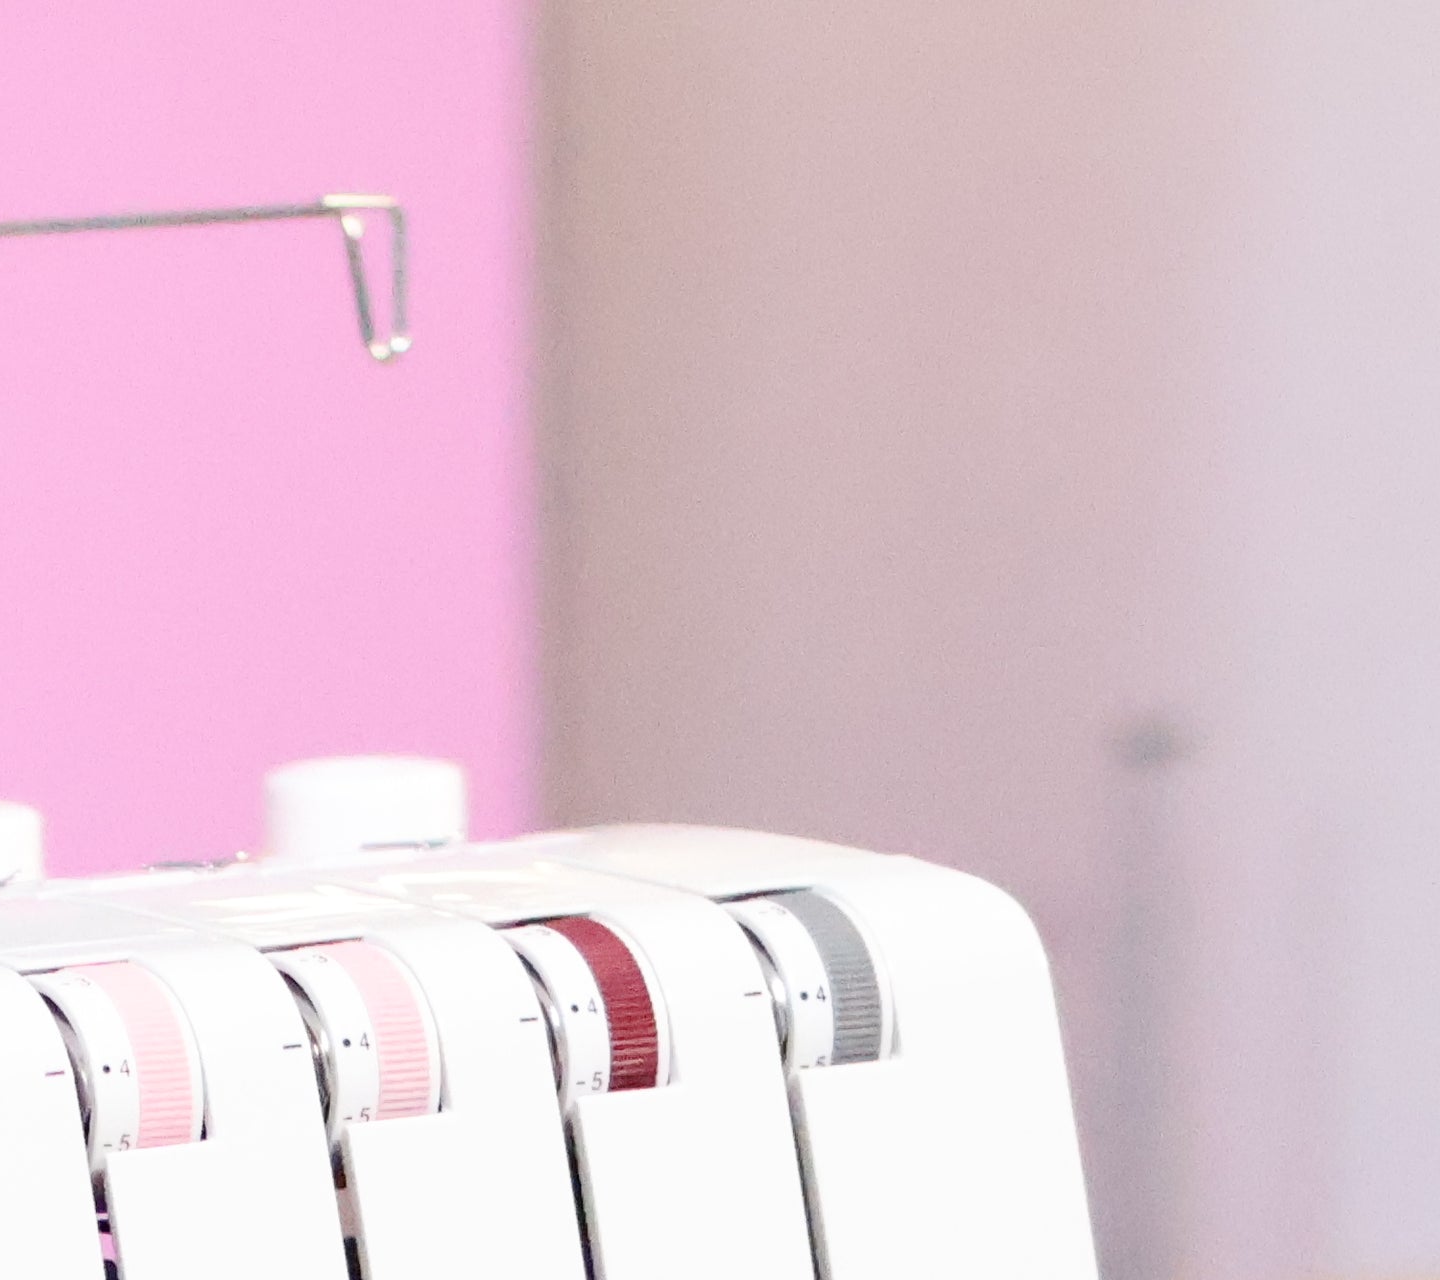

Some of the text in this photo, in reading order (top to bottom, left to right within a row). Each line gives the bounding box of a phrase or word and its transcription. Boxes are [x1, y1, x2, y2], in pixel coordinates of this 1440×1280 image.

[816, 984, 827, 1003] 4
[587, 997, 599, 1015] 4
[359, 1031, 371, 1050] 4
[119, 1059, 131, 1078] 4
[591, 1071, 604, 1091] 5
[359, 1106, 372, 1122] 5
[119, 1133, 132, 1152] 5
